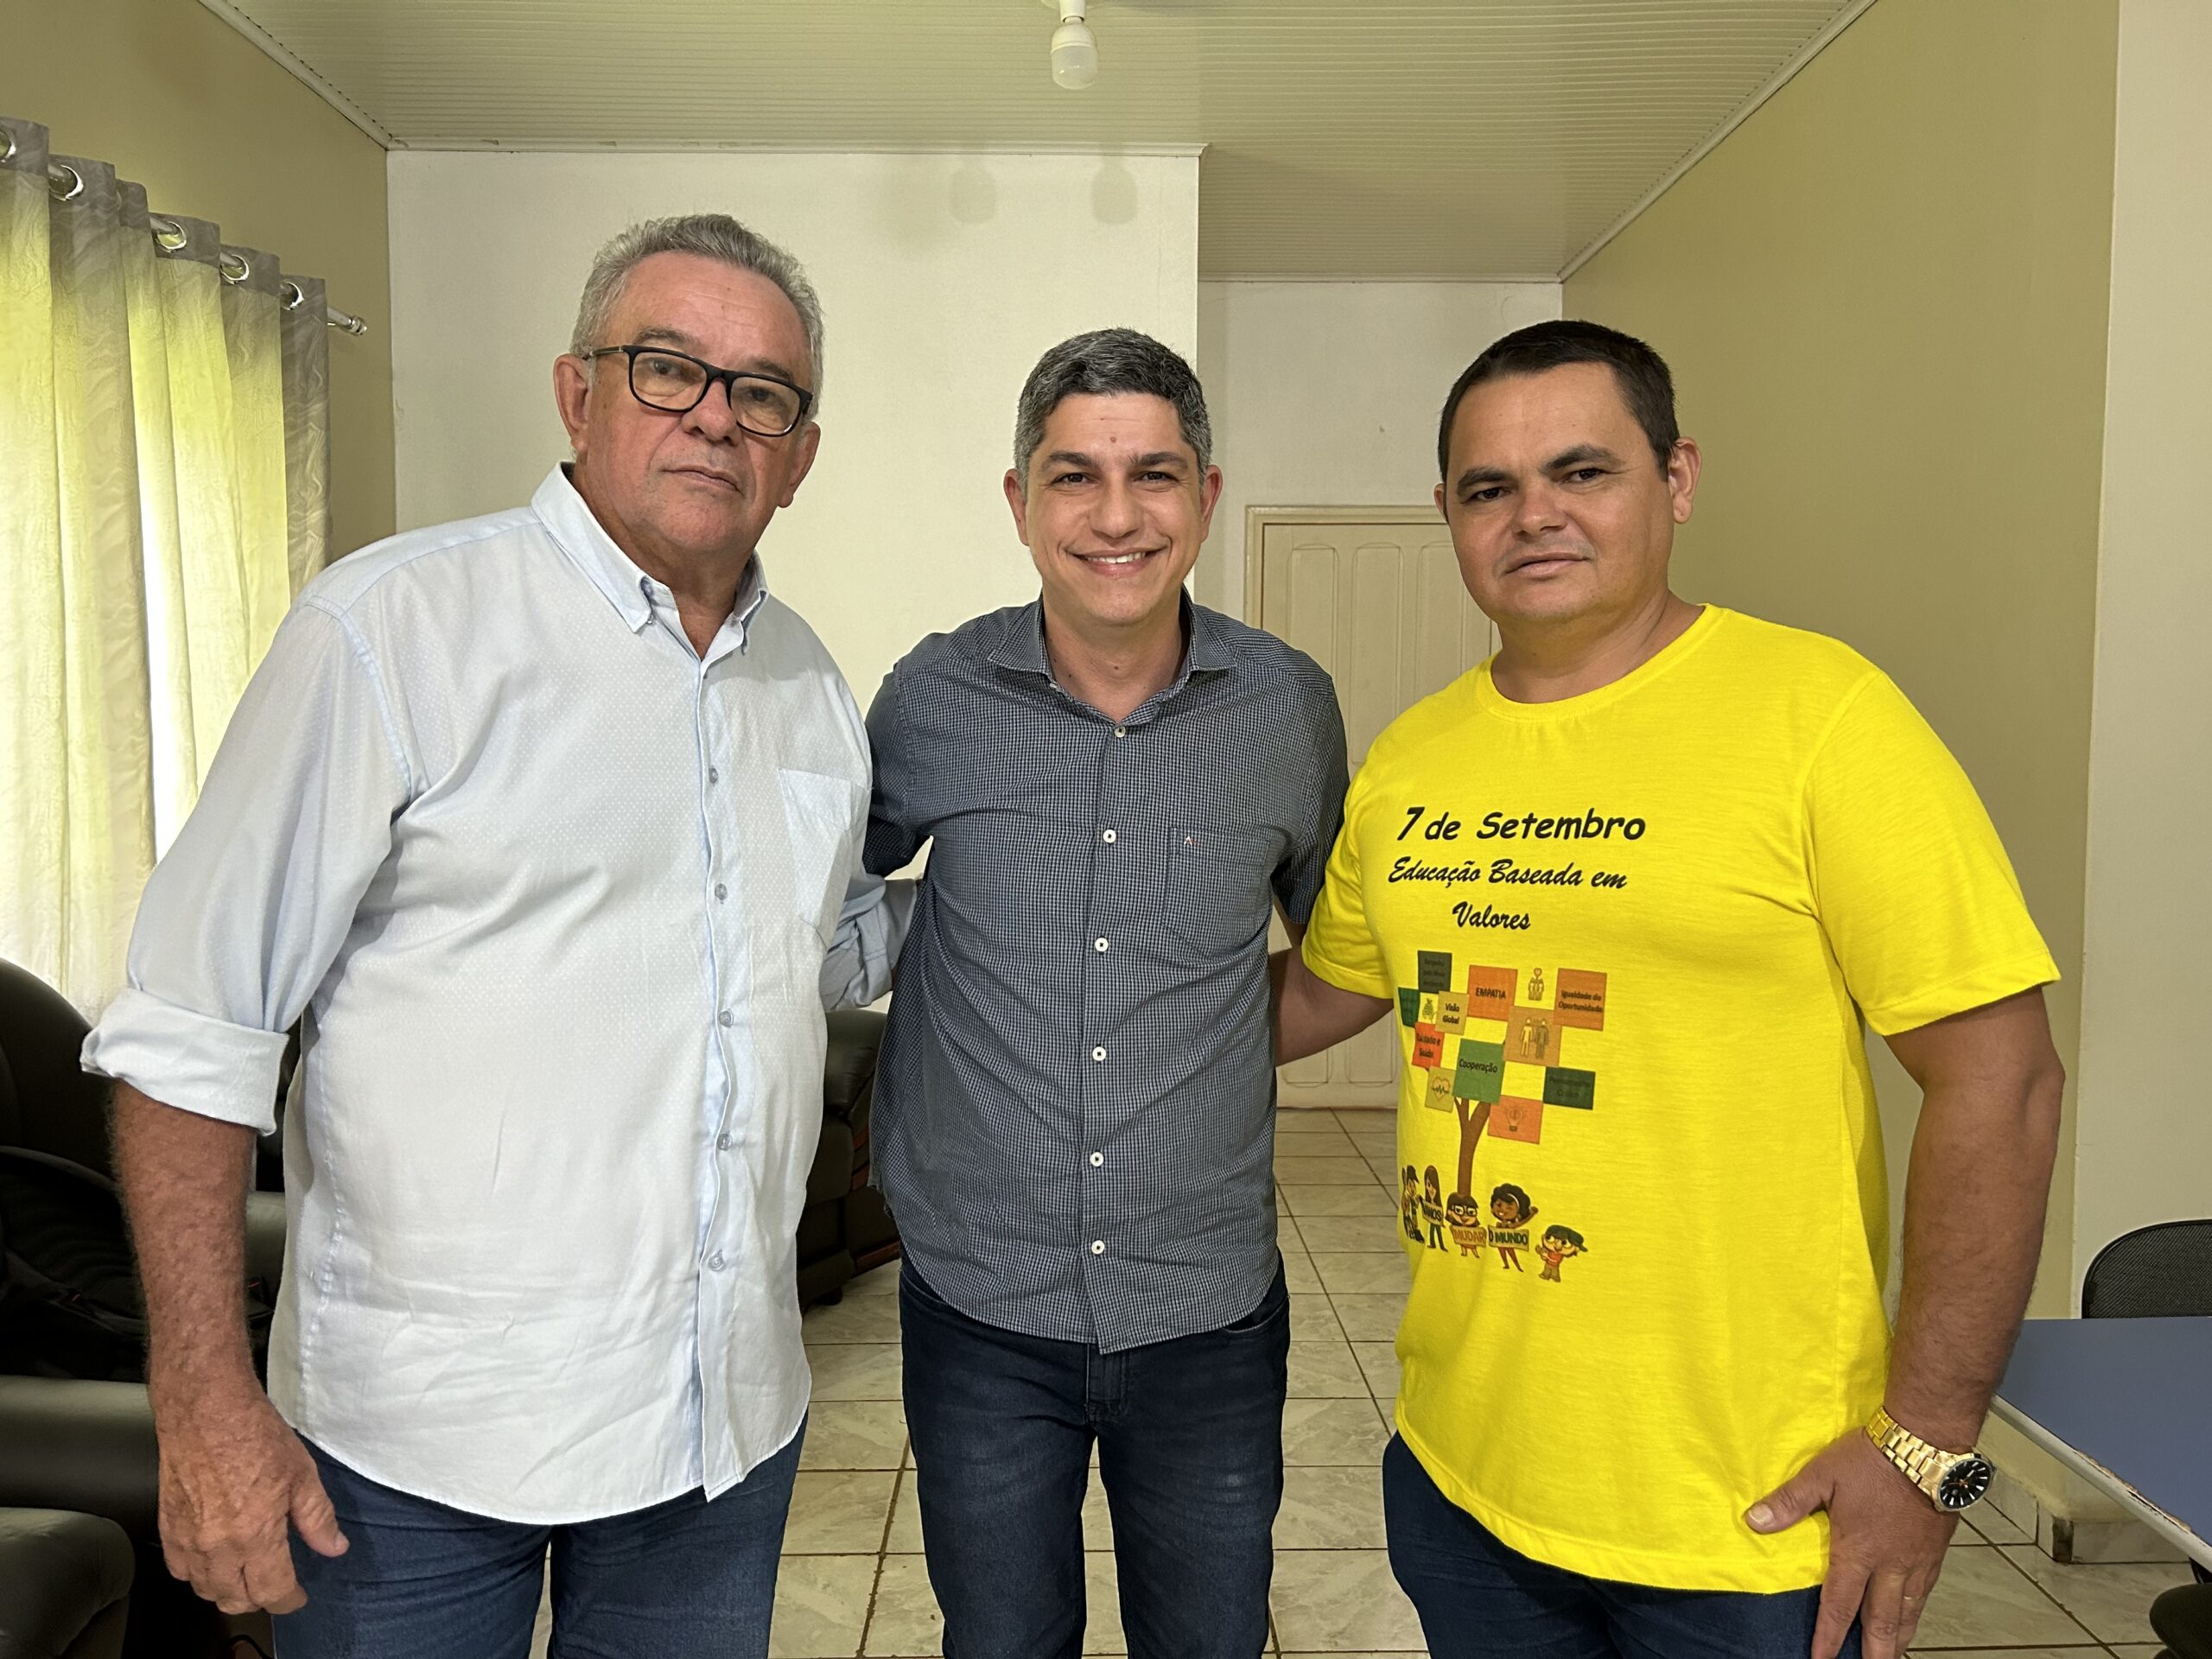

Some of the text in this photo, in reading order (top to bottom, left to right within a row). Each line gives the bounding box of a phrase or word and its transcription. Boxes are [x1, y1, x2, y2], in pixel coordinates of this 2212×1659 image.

[1397, 807, 1646, 841] 7 de Setembro
[1388, 856, 1627, 889] Educação Baseada em
[1452, 900, 1531, 930] Valores
[1475, 987, 1506, 999] EMPATIA
[1445, 1002, 1460, 1012] Visão
[1442, 1014, 1460, 1025] Global
[1459, 1058, 1497, 1074] Cooperação
[1495, 1231, 1529, 1245] MUNDO
